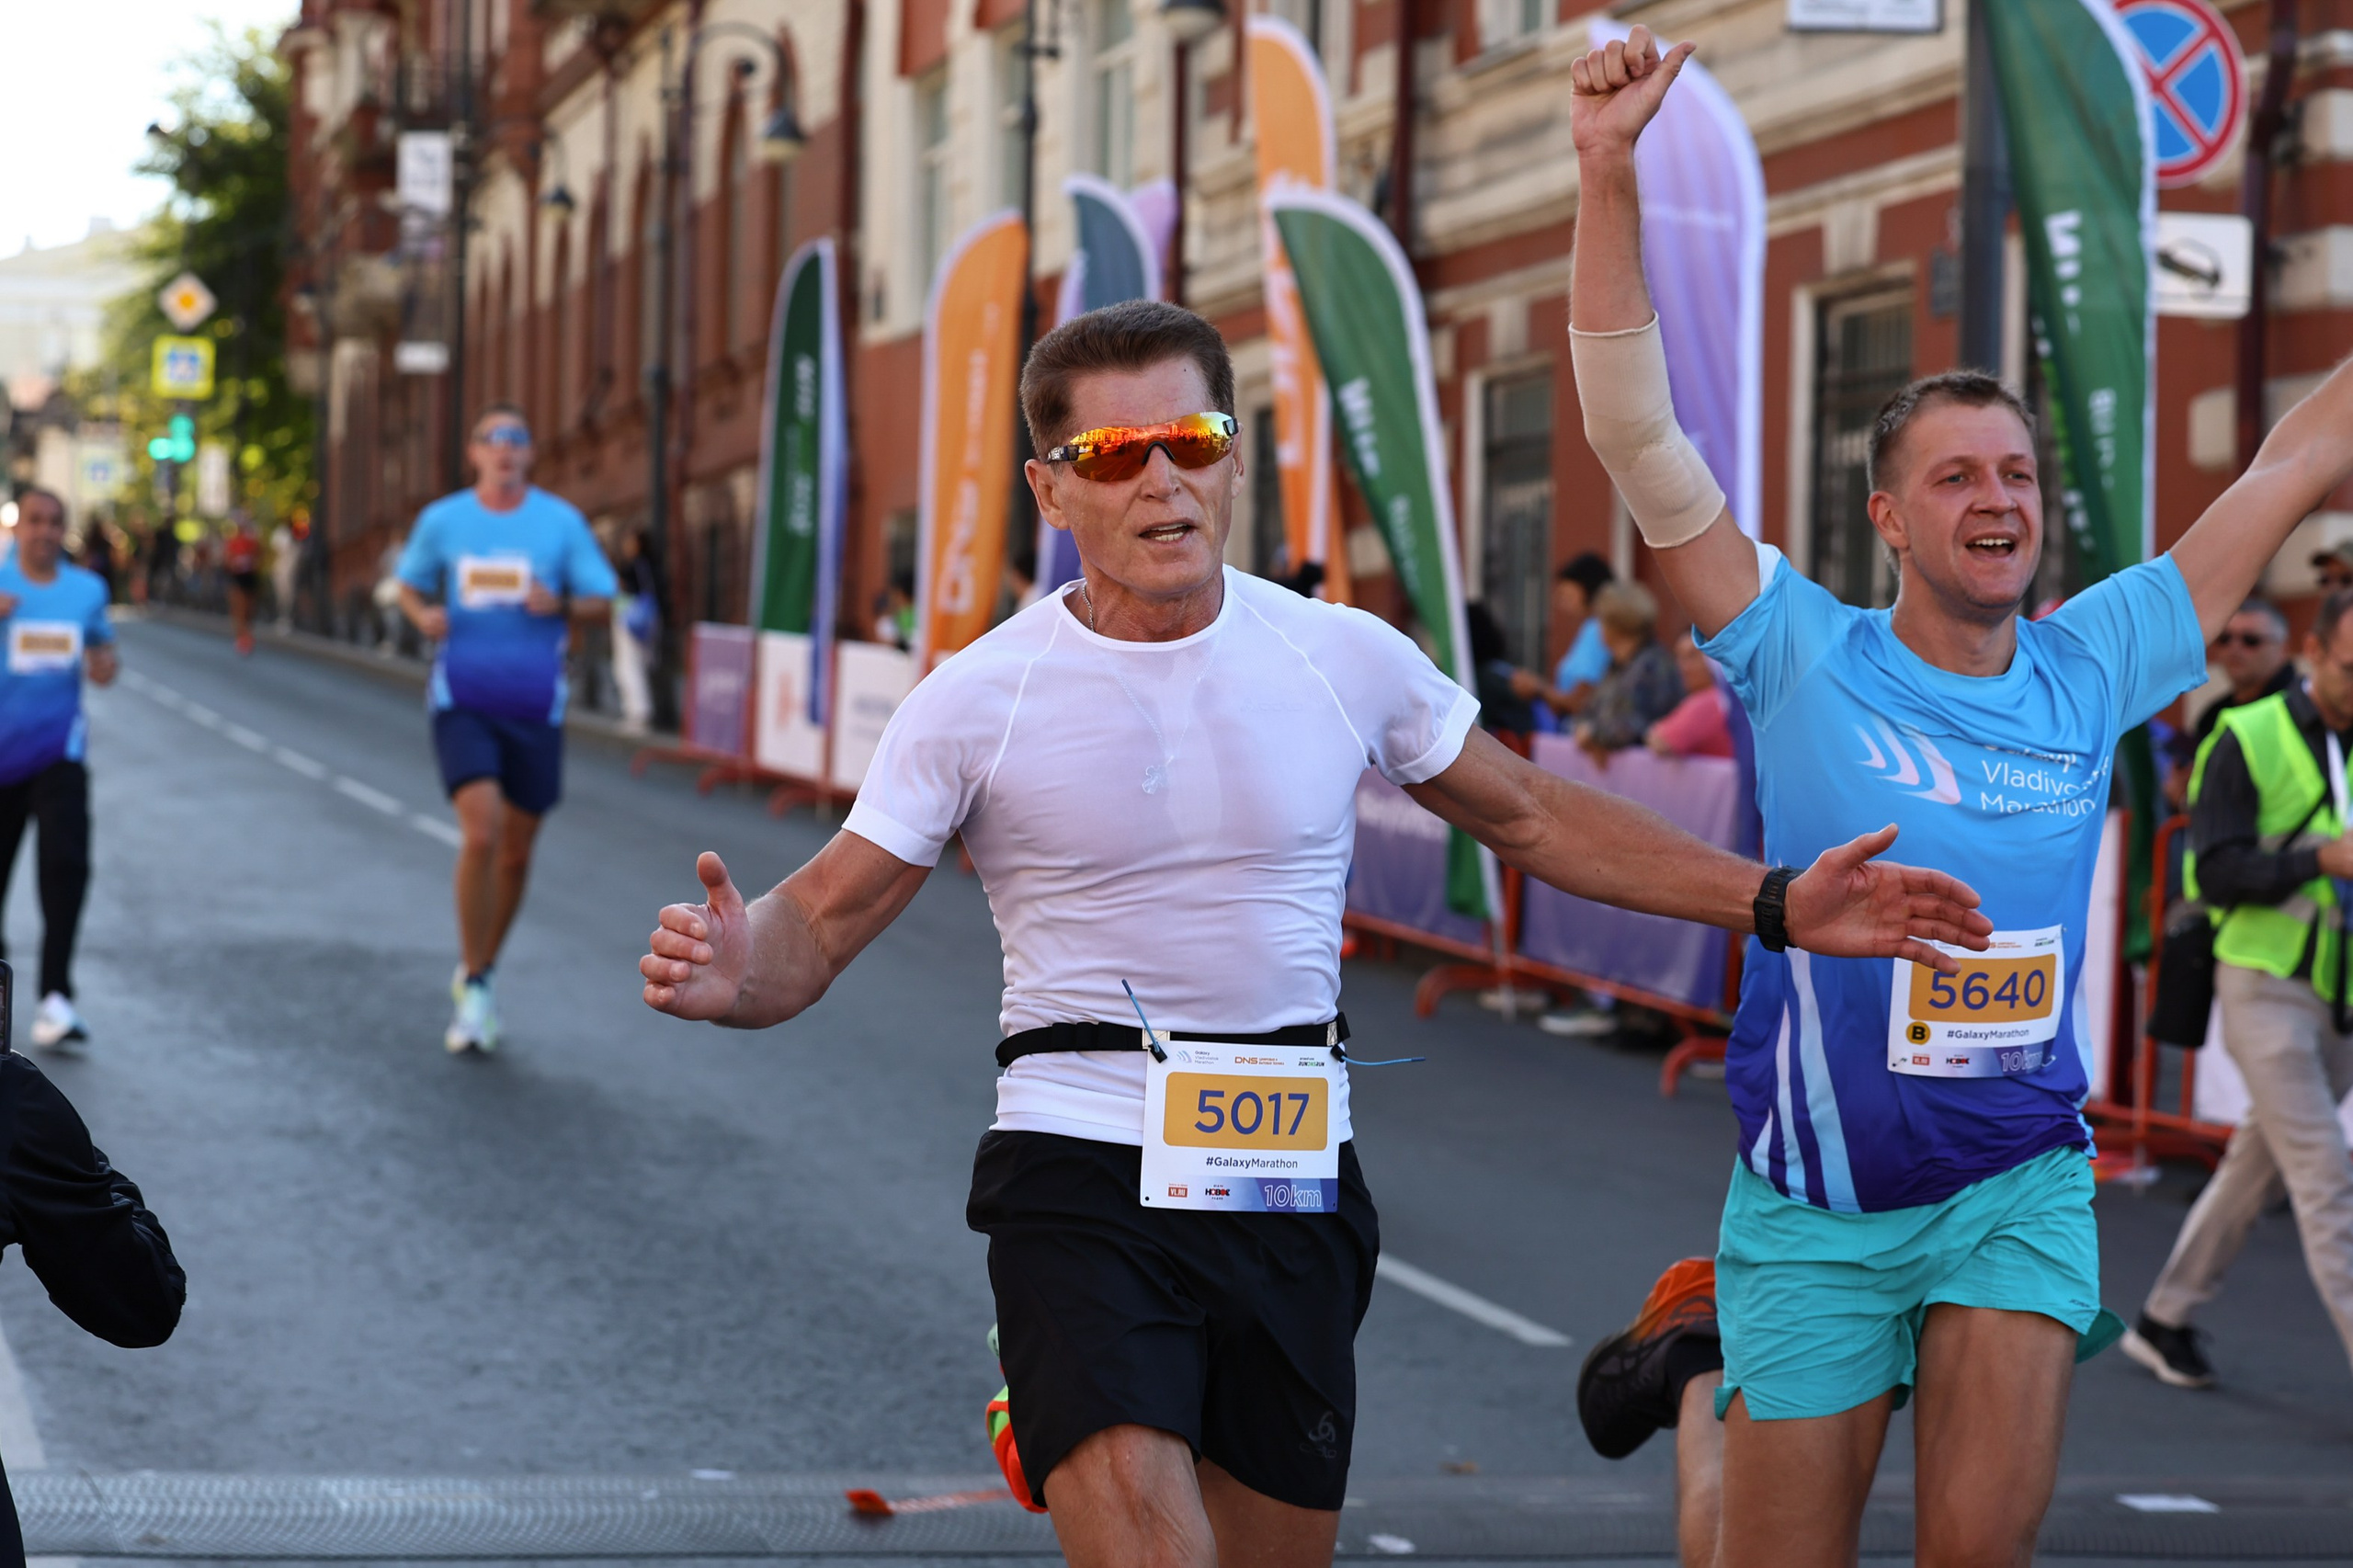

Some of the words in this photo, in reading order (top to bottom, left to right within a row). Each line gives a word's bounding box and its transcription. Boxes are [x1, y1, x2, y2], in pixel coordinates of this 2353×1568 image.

[1928, 970, 2045, 1010] 5640
[1912, 1026, 1926, 1040] B
[1947, 1028, 2029, 1040] #GalaxyMarathon
[1234, 1056, 1258, 1064] DNS
[1195, 1089, 1310, 1135] 5017
[1206, 1156, 1298, 1169] #GalaxyMarathon
[1264, 1185, 1322, 1208] 10km
